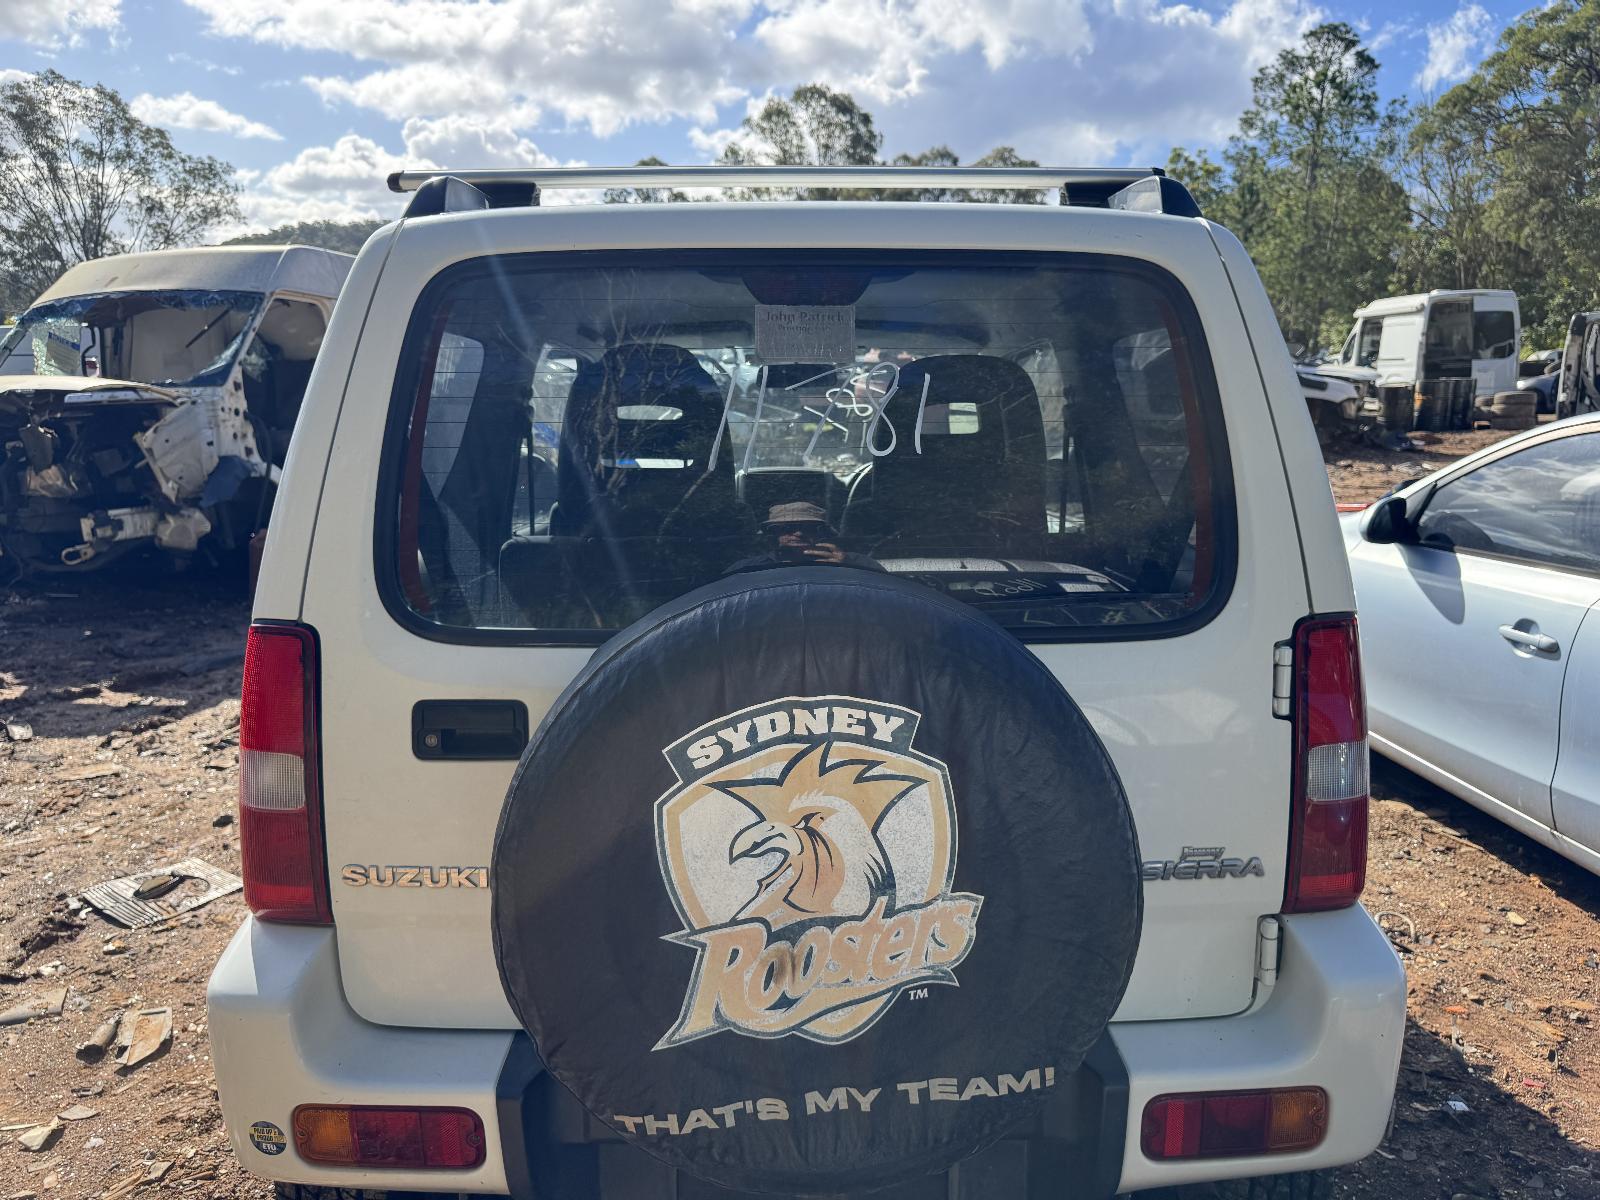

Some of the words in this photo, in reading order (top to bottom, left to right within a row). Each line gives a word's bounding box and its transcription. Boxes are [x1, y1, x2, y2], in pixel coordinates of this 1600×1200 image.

[767, 311, 796, 322] John
[686, 706, 905, 769] SYDNEY
[342, 864, 489, 889] SUZUKI
[1142, 856, 1265, 881] SIERRA
[676, 896, 978, 1030] Roosters
[908, 988, 929, 1001] TM
[613, 1097, 790, 1135] THAT'S
[805, 1086, 882, 1115] MY
[897, 1066, 1056, 1105] TEAM!
